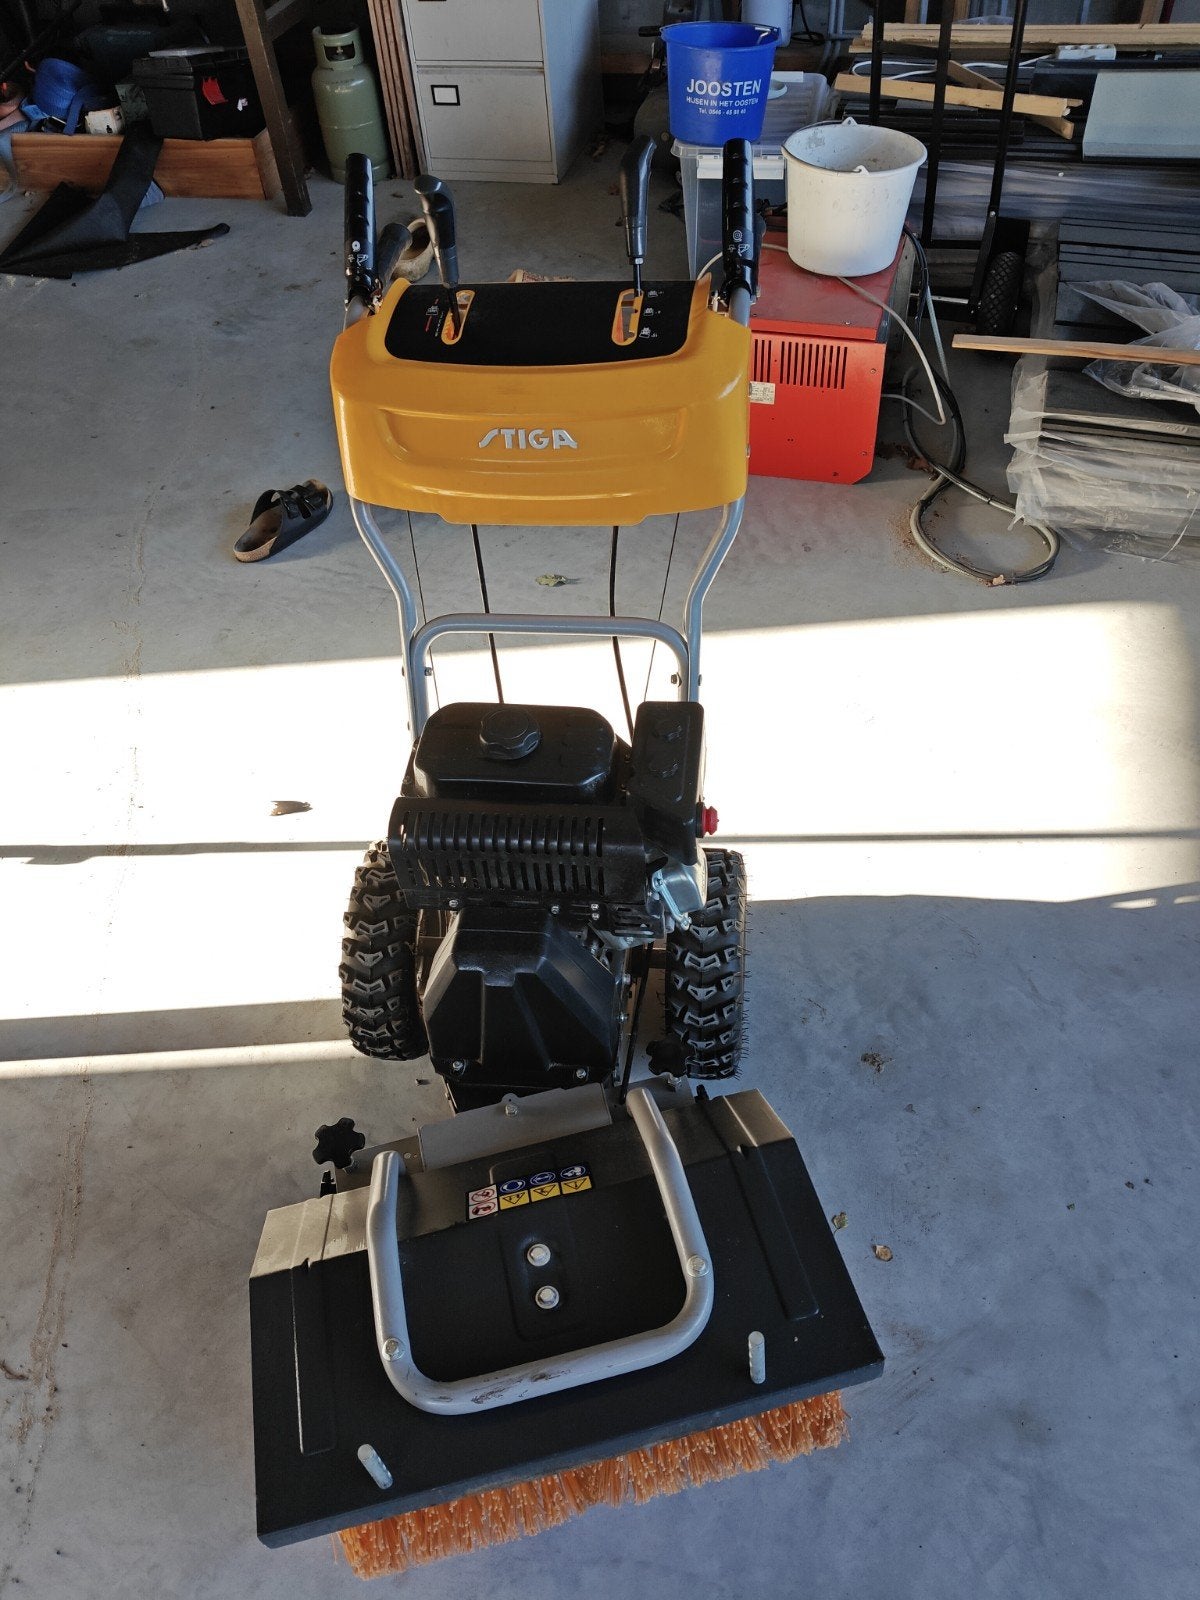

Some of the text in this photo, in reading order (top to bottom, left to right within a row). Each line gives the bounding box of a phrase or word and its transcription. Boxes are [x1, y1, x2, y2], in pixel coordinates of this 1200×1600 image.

[686, 79, 762, 97] JOOSTEN
[710, 99, 718, 107] IN
[719, 100, 733, 108] HET
[734, 97, 759, 106] OOSTEN
[478, 428, 578, 450] STIGA
